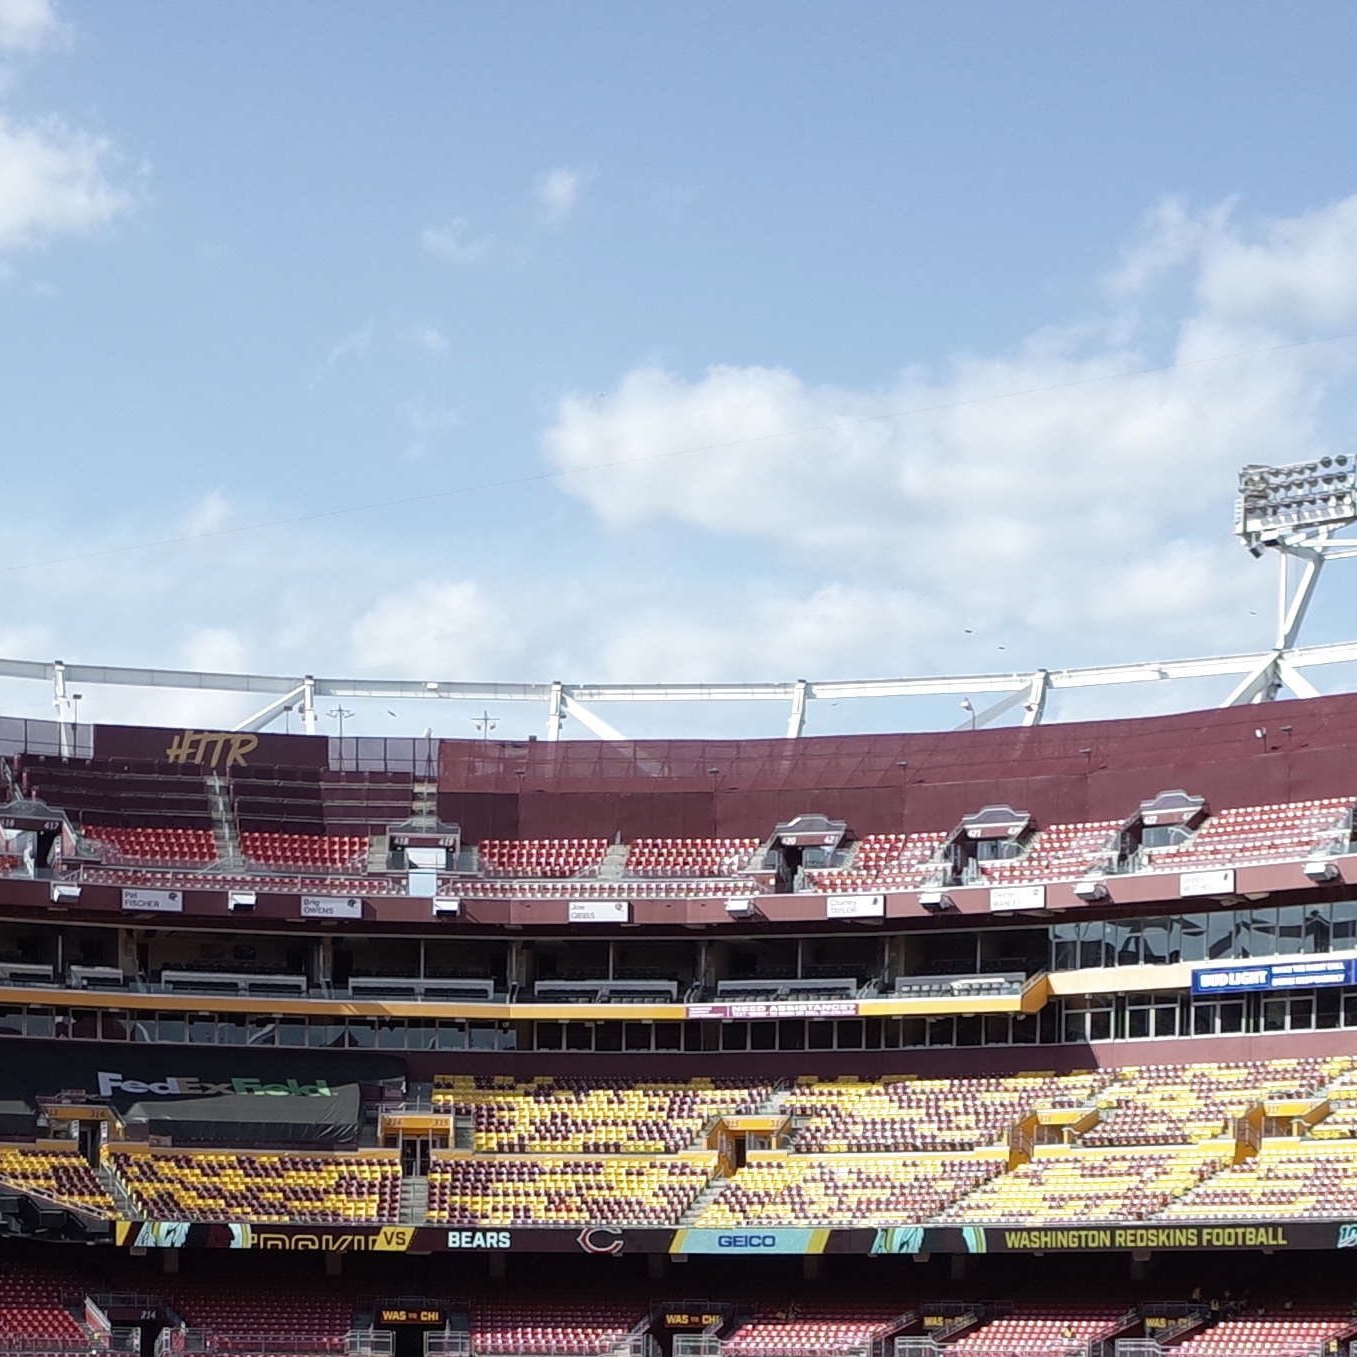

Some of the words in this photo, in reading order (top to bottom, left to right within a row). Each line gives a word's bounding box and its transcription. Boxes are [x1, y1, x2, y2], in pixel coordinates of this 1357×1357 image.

[166, 730, 259, 768] HTTR
[124, 899, 160, 909] FISCHER
[1200, 971, 1228, 988] BUD
[1228, 969, 1268, 986] LIGHT
[96, 1071, 333, 1098] FedExField
[383, 1231, 406, 1247] VS
[447, 1231, 511, 1249] BEARS
[718, 1234, 776, 1248] GEICO
[1005, 1230, 1113, 1249] WASHINGTON
[1115, 1228, 1198, 1248] REDSKINS
[1201, 1227, 1288, 1246] FOOTBALL
[382, 1310, 407, 1321] WAS
[421, 1310, 439, 1321] CHI
[665, 1313, 689, 1325] WAS
[923, 1316, 943, 1327] WAS
[1145, 1317, 1167, 1329] WAS
